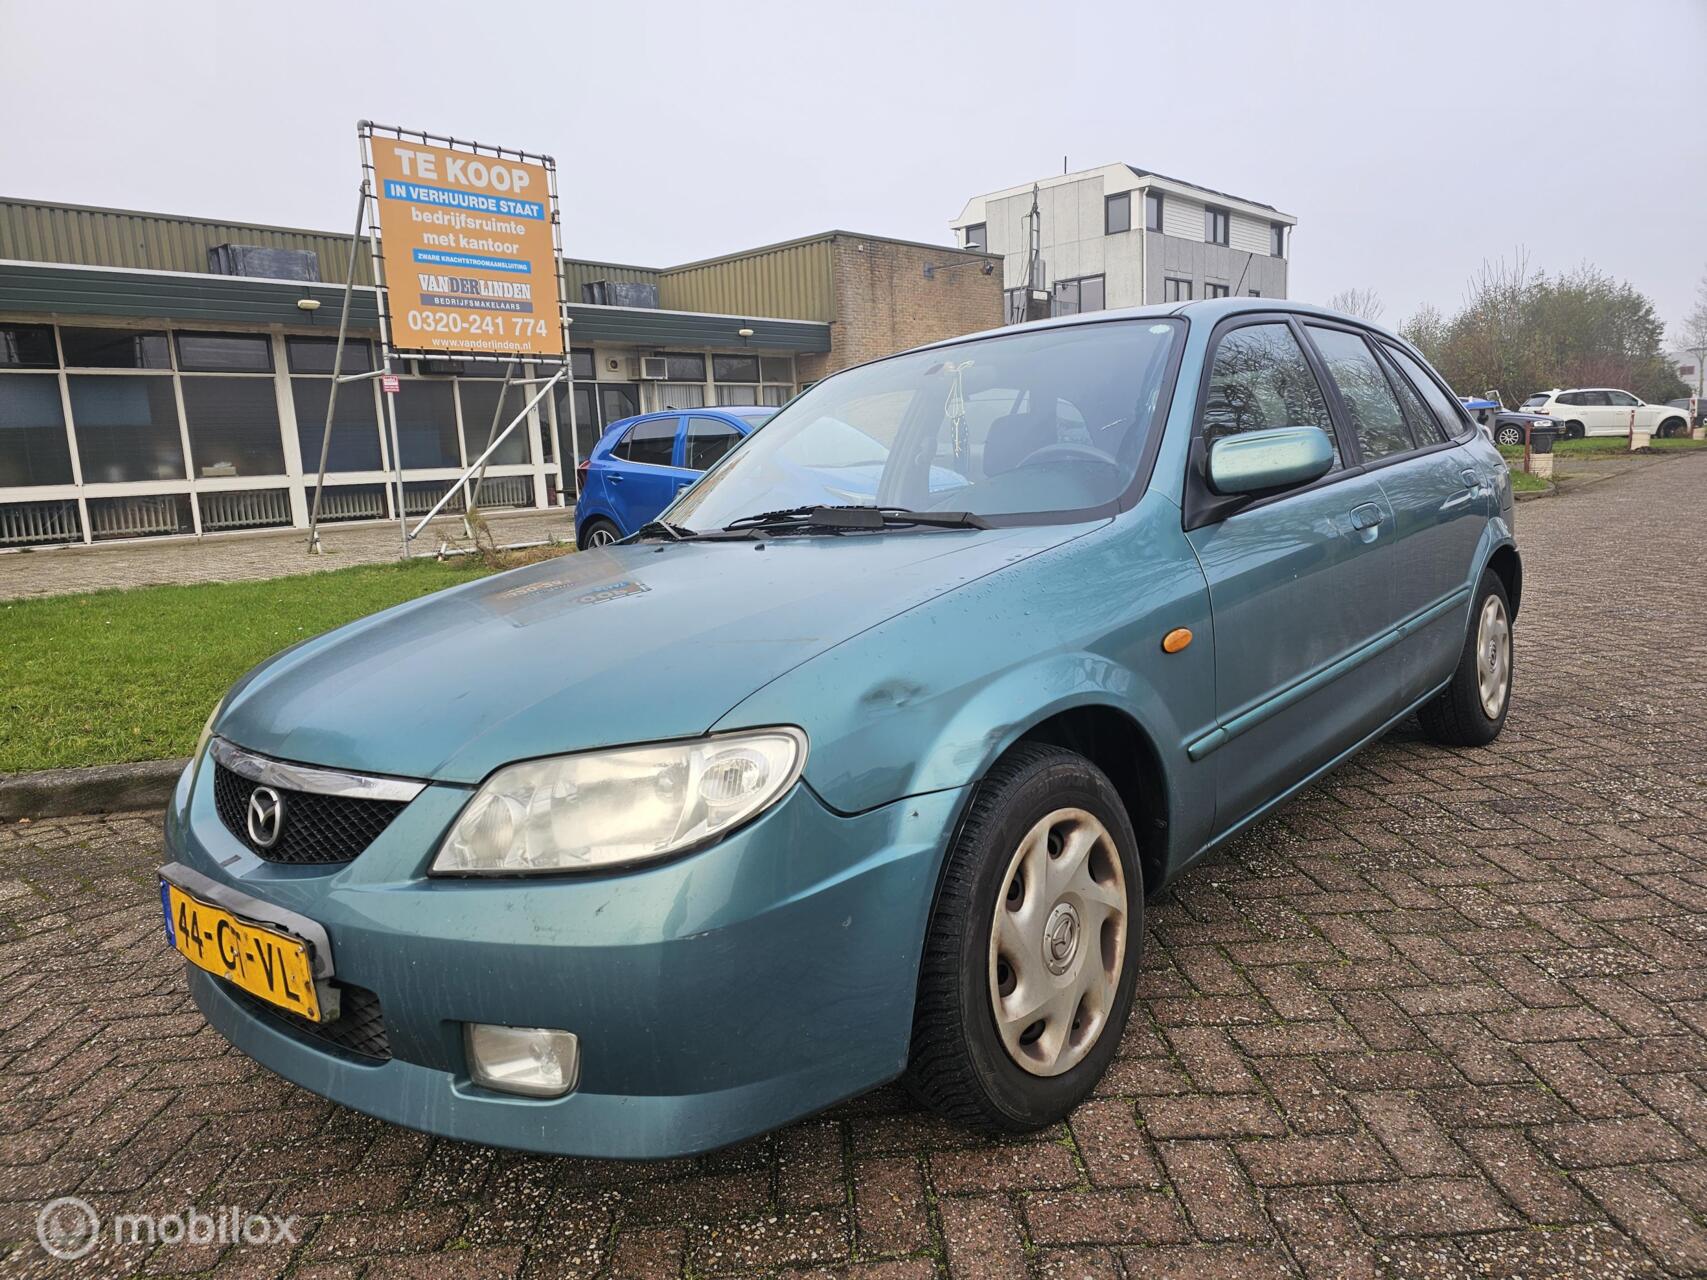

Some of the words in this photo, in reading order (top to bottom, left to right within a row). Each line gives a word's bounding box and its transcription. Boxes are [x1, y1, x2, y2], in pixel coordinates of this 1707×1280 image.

[394, 147, 438, 180] TE
[446, 156, 530, 194] KOOP
[390, 183, 407, 198] IN
[409, 186, 497, 212] VERHUURDE
[500, 201, 539, 217] STAAT
[411, 206, 526, 236] bedrijfsruimte
[423, 232, 456, 248] met
[459, 237, 519, 255] kantoor
[434, 297, 521, 311] BEDRIJFSMAKELAARS
[407, 310, 504, 336] 0320-241
[512, 317, 548, 337] 774
[431, 337, 531, 351] www.vanderlinden.nl
